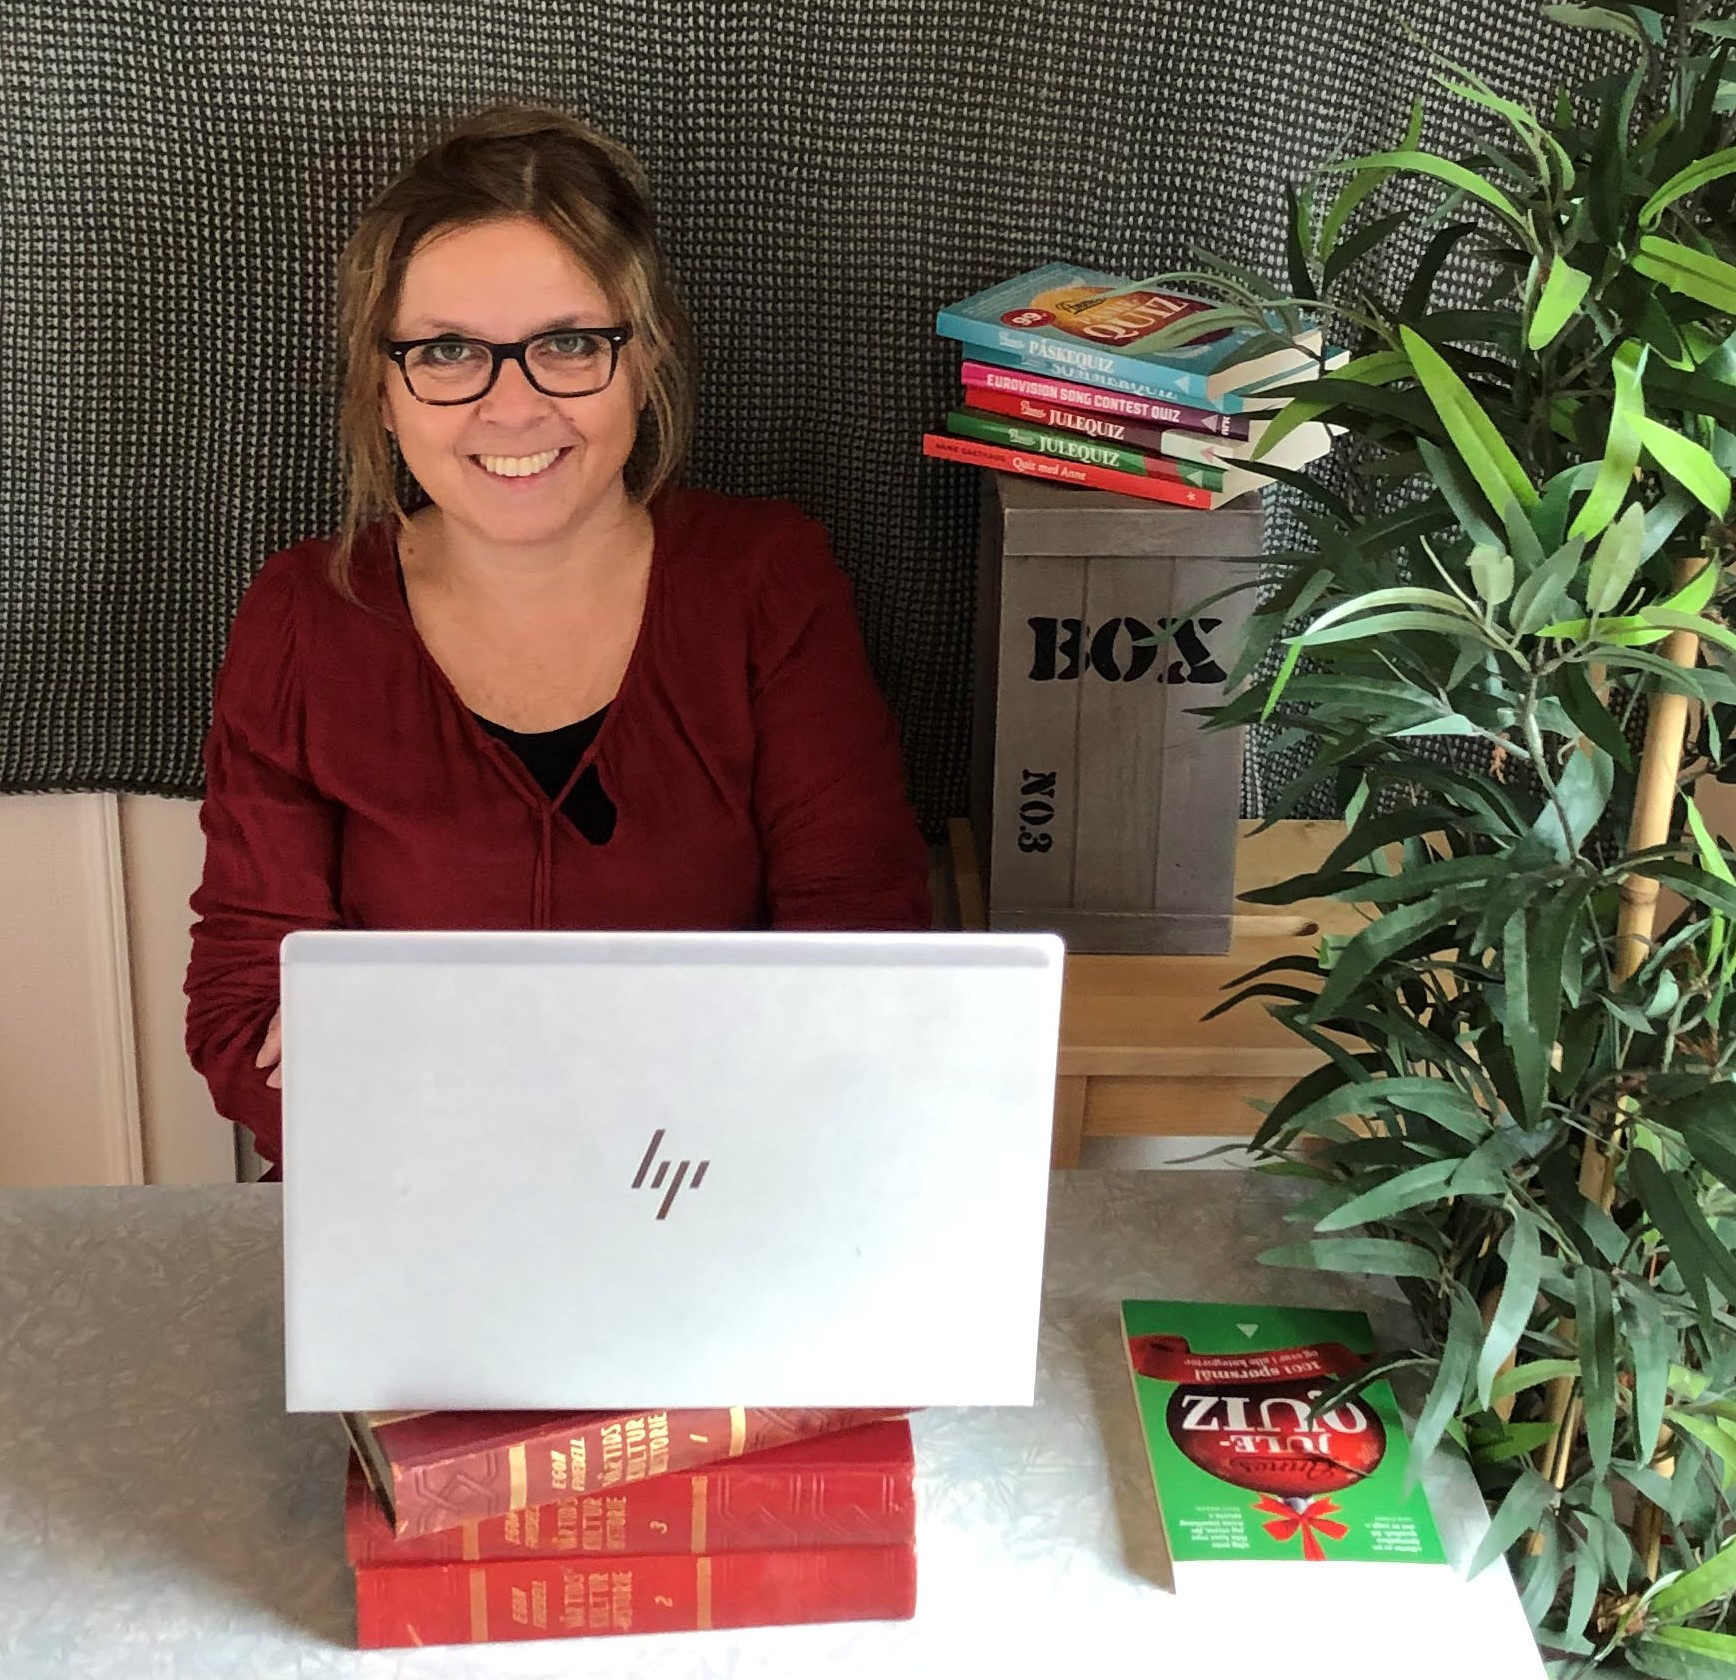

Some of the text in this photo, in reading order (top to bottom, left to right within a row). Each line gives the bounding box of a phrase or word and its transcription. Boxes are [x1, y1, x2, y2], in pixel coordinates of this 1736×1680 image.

[1083, 296, 1190, 340] QUIZ
[1029, 337, 1116, 373] PÅSKEQUIZ
[986, 373, 1181, 422] EUROVISION SONG CONTEST QUIZ
[1048, 409, 1125, 440] JULEQUIZ
[1039, 435, 1120, 467] JULEQUIZ
[1012, 456, 1087, 481] Quiz med Anne
[1027, 616, 1228, 685] BOX
[1194, 1360, 1322, 1382] 1001 spørsmål
[1182, 1390, 1367, 1433] QUIZ
[1220, 1432, 1332, 1455] JULE-
[551, 1449, 567, 1489] EGON
[650, 1519, 668, 1534] 3
[655, 1594, 673, 1608] 2
